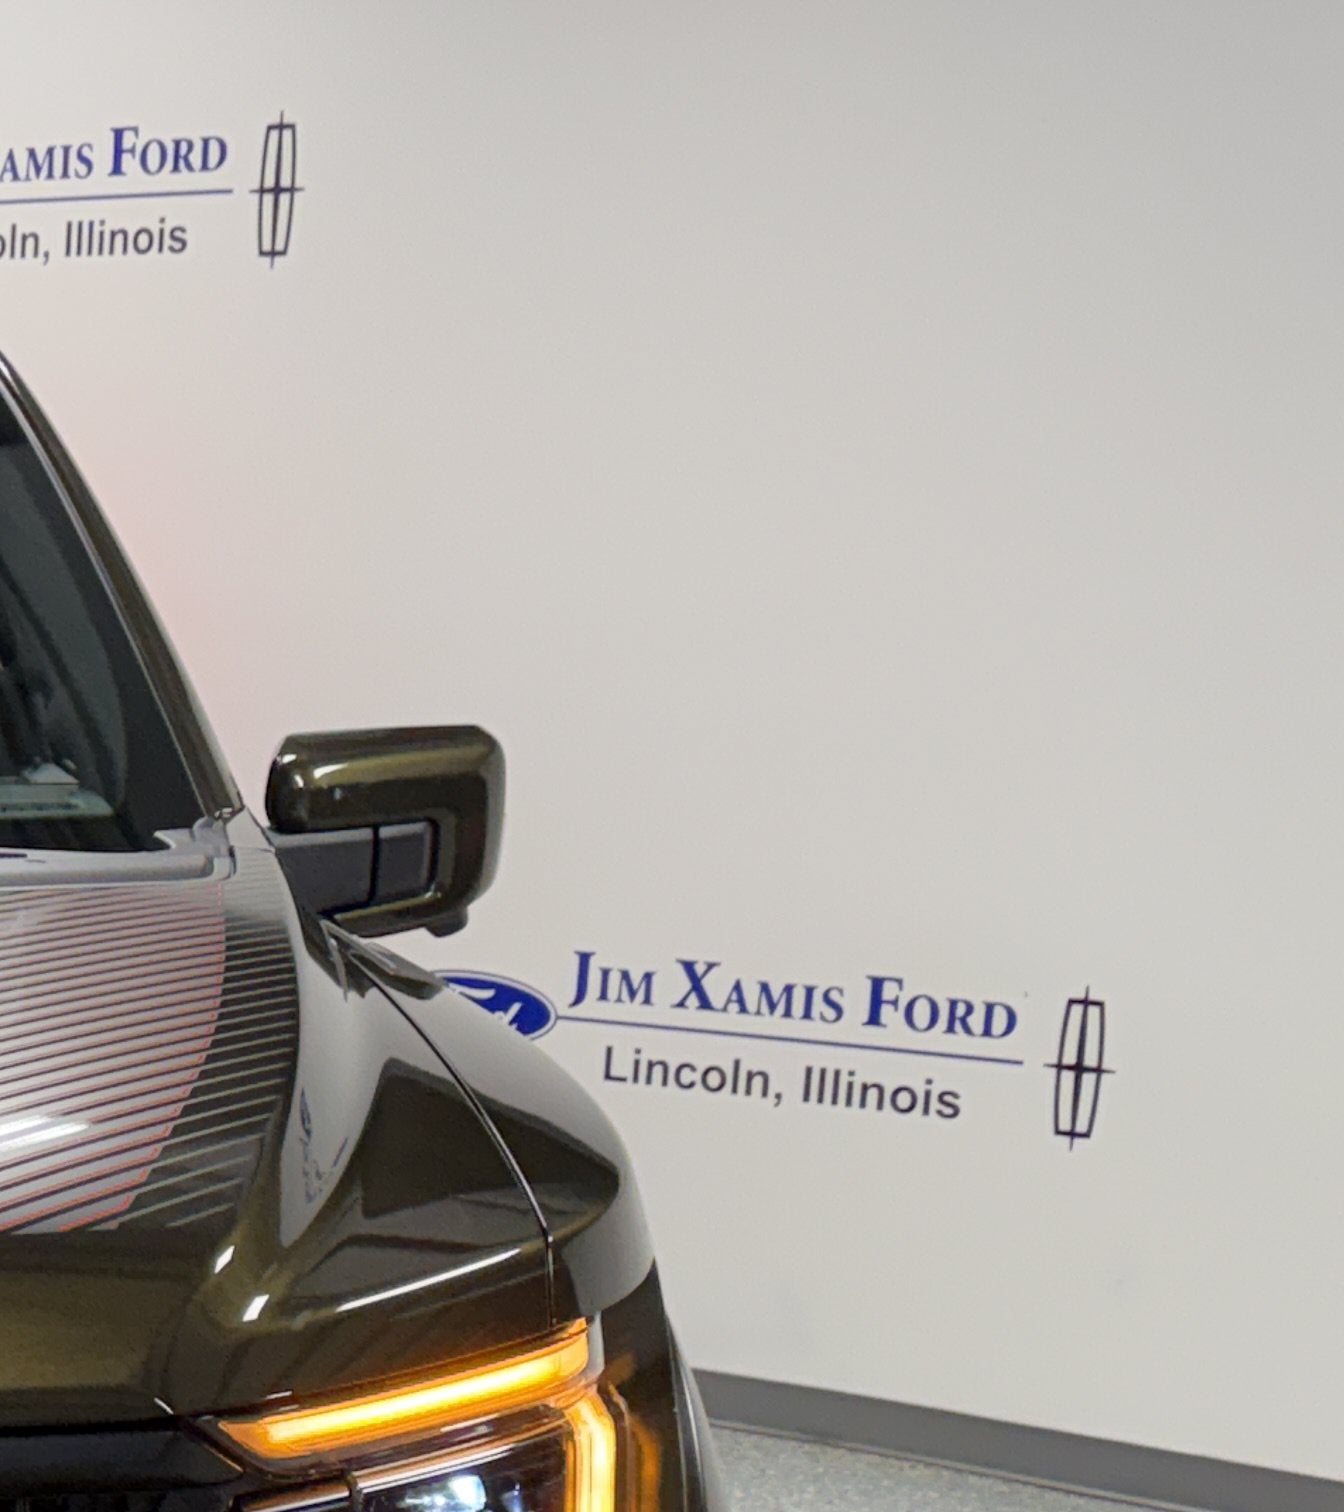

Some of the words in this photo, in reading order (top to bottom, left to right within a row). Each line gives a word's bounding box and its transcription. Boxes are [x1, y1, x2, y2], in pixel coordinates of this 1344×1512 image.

[107, 125, 228, 177] FORD
[64, 217, 189, 258] Illinois
[567, 950, 655, 1009] JIM
[672, 958, 846, 1024] XAMIS
[860, 974, 1019, 1041] FORD
[602, 1045, 784, 1108] Lincoln,
[801, 1065, 962, 1121] Illinois
